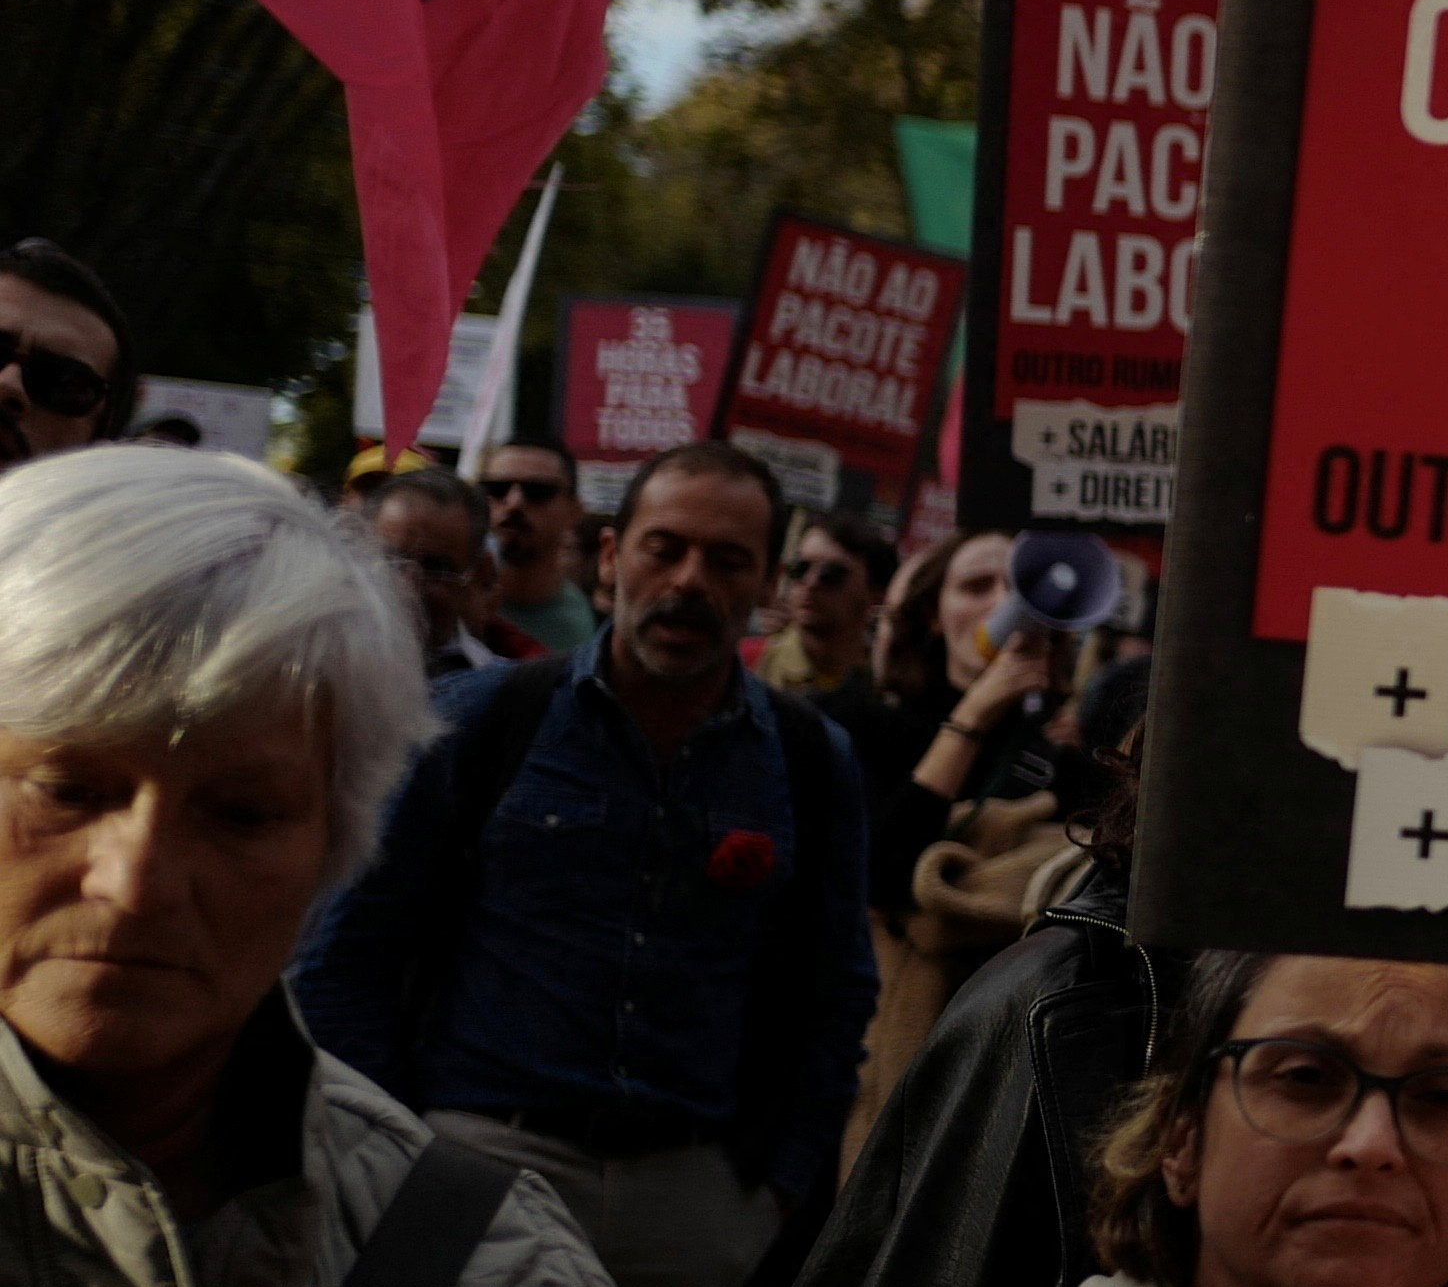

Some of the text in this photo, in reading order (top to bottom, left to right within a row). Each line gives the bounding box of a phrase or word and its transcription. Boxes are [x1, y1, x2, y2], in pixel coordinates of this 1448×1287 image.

[1044, 114, 1200, 221] PAC
[789, 236, 940, 322] NÃO AO
[768, 291, 929, 378] PACOTE
[1012, 348, 1180, 390] OUTRO RUM
[739, 341, 919, 435] LABORAL
